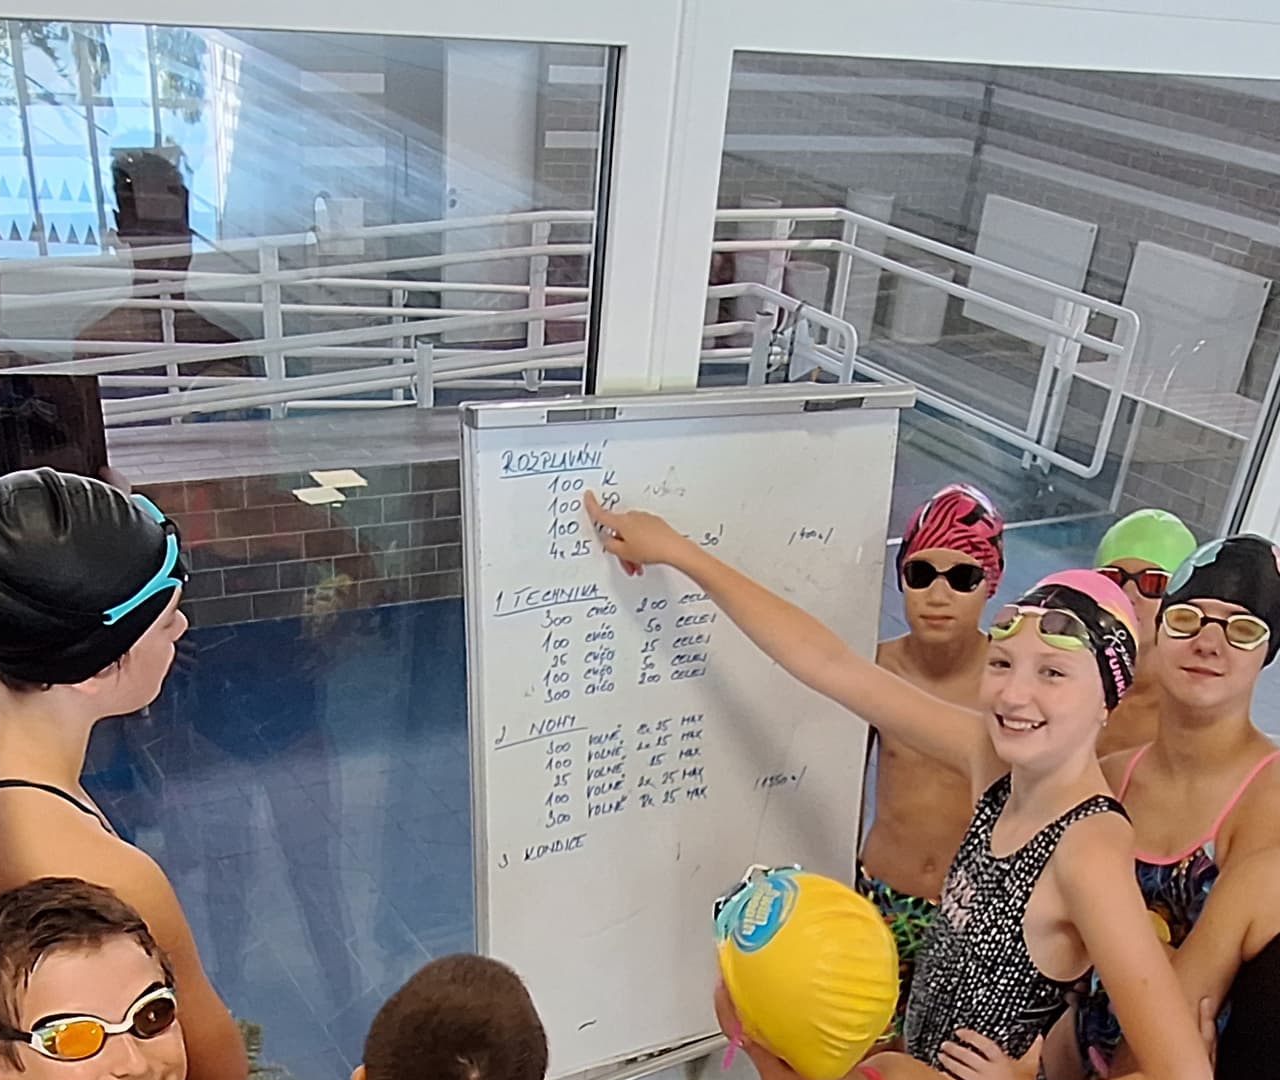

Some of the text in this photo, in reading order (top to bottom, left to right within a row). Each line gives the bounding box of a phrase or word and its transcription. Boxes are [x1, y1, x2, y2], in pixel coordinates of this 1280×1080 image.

[548, 476, 583, 494] 100
[548, 497, 581, 516] 100
[548, 520, 580, 540] 100
[571, 540, 592, 556] 25
[514, 584, 600, 607] TECHNIKA
[541, 610, 572, 628] 300
[636, 597, 668, 613] 200
[542, 631, 569, 652] 100
[644, 617, 662, 633] 50
[543, 672, 570, 687] 100
[640, 656, 656, 671] 50
[544, 688, 570, 704] 300
[638, 672, 661, 685] 200
[530, 715, 576, 736] NOHY
[546, 740, 571, 756] 300
[546, 755, 572, 770] 100
[553, 772, 572, 788] 25
[546, 793, 569, 807] 100
[546, 810, 571, 828] 300
[523, 833, 588, 862] KONDICE
